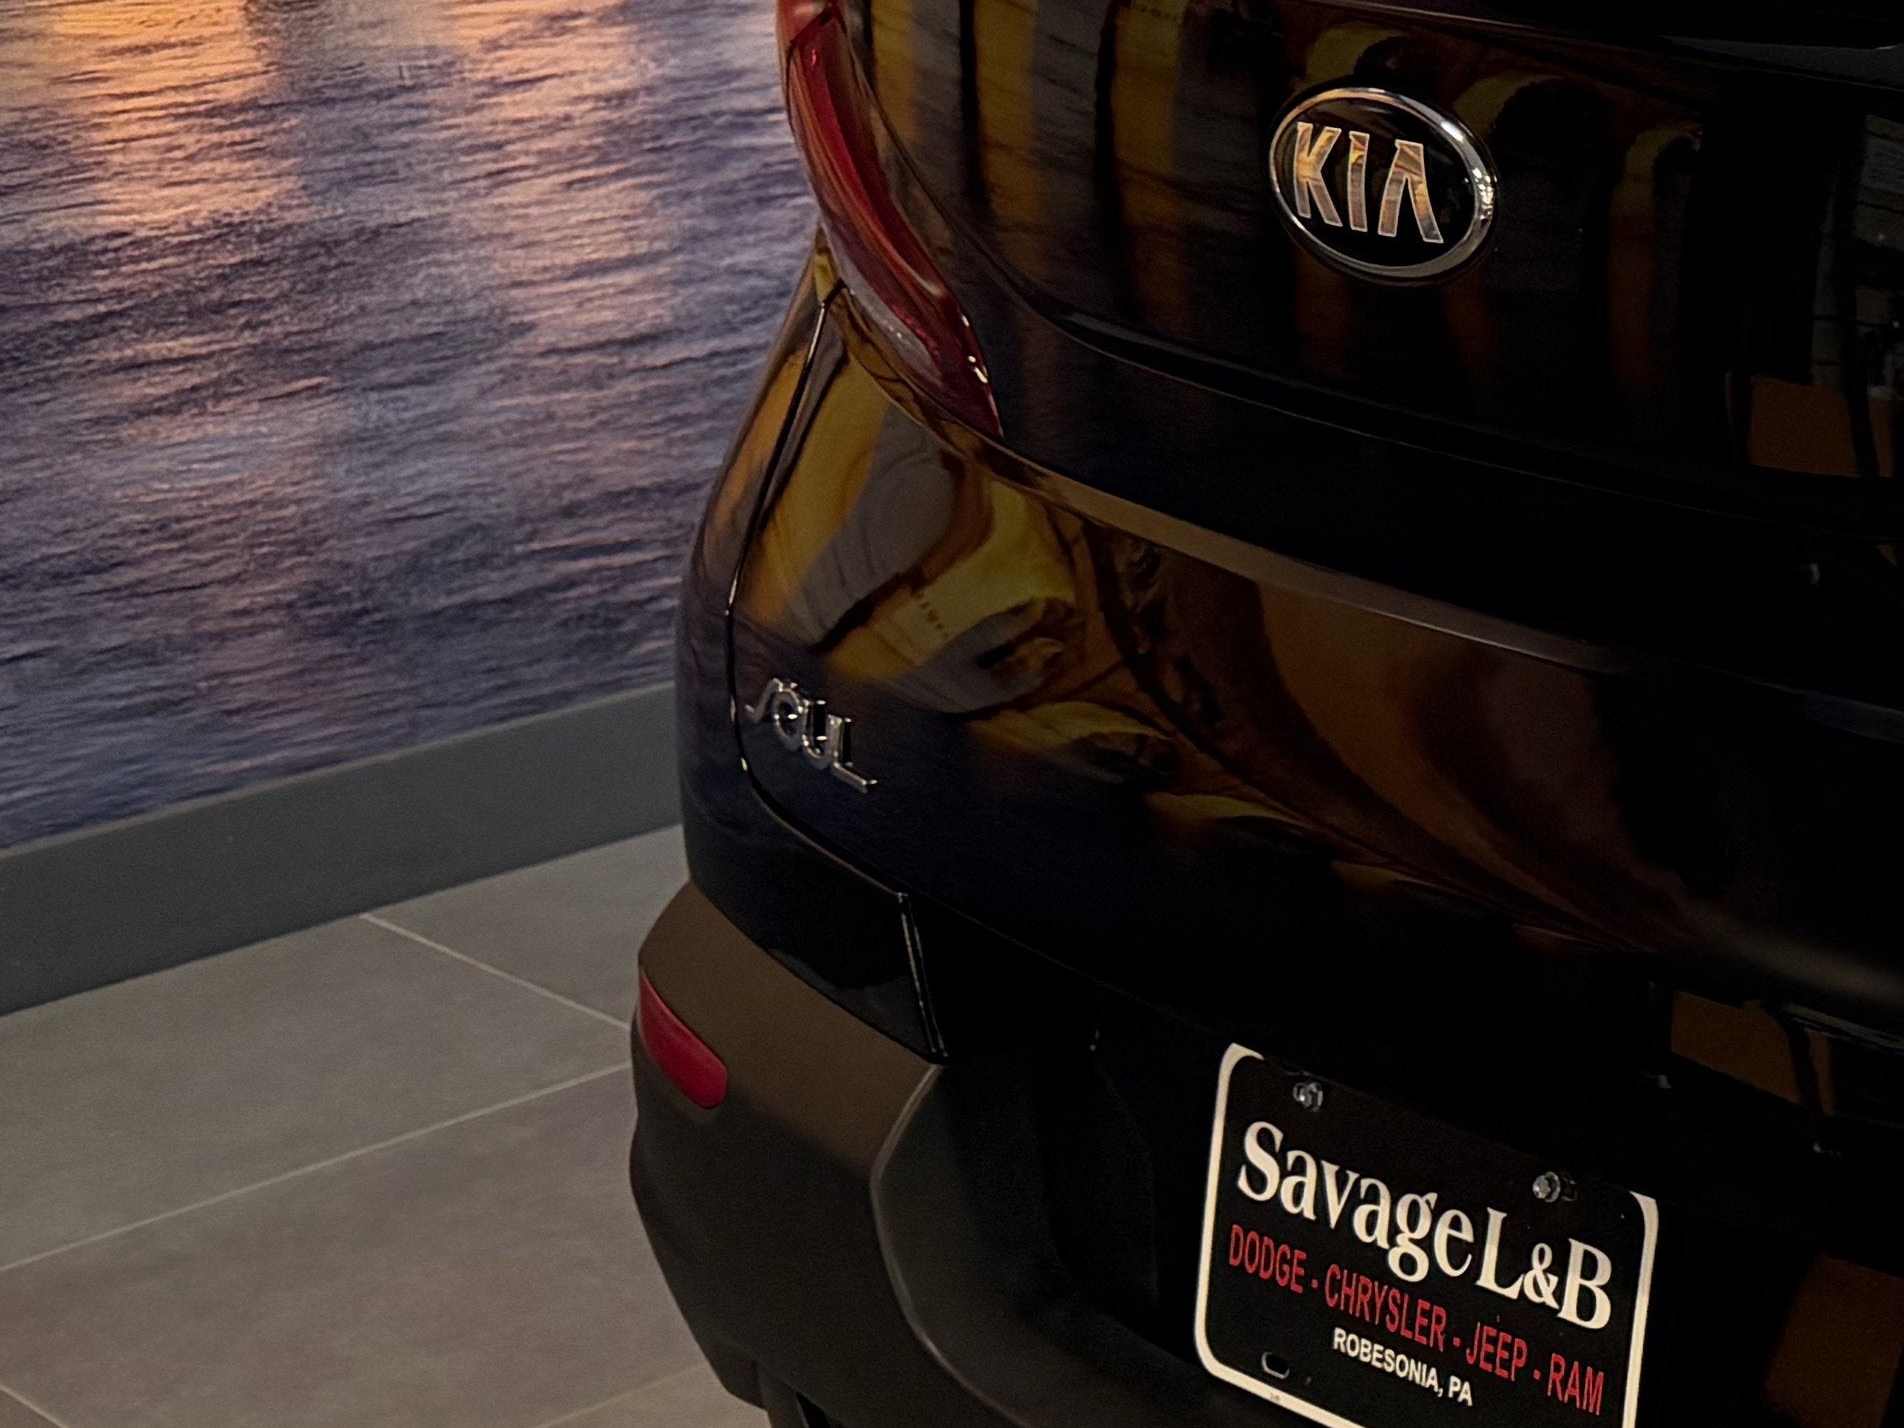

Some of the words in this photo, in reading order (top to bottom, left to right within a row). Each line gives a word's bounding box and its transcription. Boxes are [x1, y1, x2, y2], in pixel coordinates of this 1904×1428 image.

[1294, 121, 1444, 243] KIA
[1229, 1224, 1307, 1294] DODGE
[1324, 1264, 1447, 1352] CHRYSLER
[1465, 1322, 1528, 1382] JEEP
[1547, 1353, 1605, 1415] RAM
[1332, 1327, 1444, 1398] ROBESONIA,
[1447, 1375, 1473, 1407] PA
